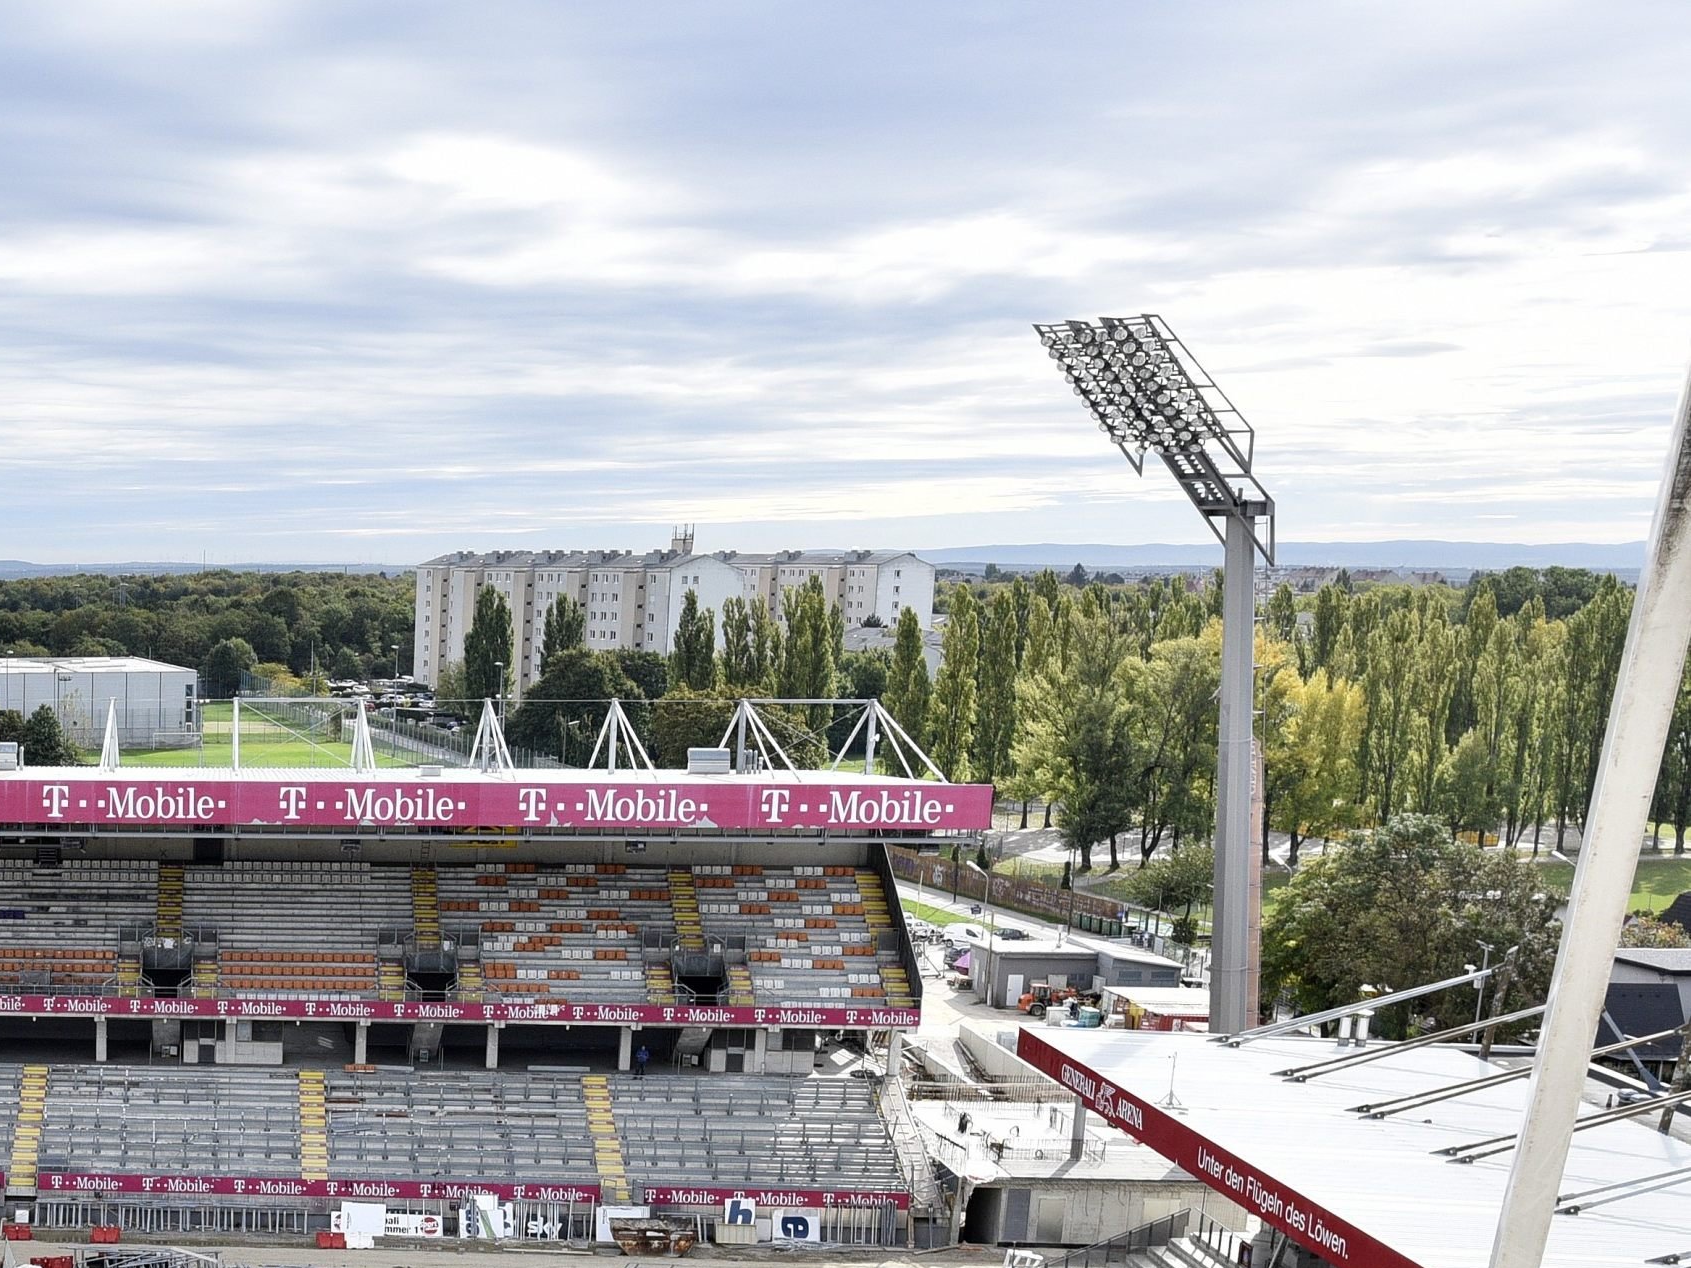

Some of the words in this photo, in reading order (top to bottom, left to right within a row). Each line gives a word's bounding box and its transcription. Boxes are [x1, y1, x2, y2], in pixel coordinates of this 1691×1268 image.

[1060, 1063, 1096, 1101] GENERALI
[1116, 1100, 1143, 1130] ARENA
[1196, 1146, 1224, 1181] Unter
[1225, 1165, 1245, 1194] den
[1246, 1175, 1284, 1218] Flügeln
[1285, 1201, 1306, 1232] des
[1307, 1211, 1349, 1259] Löwen.
